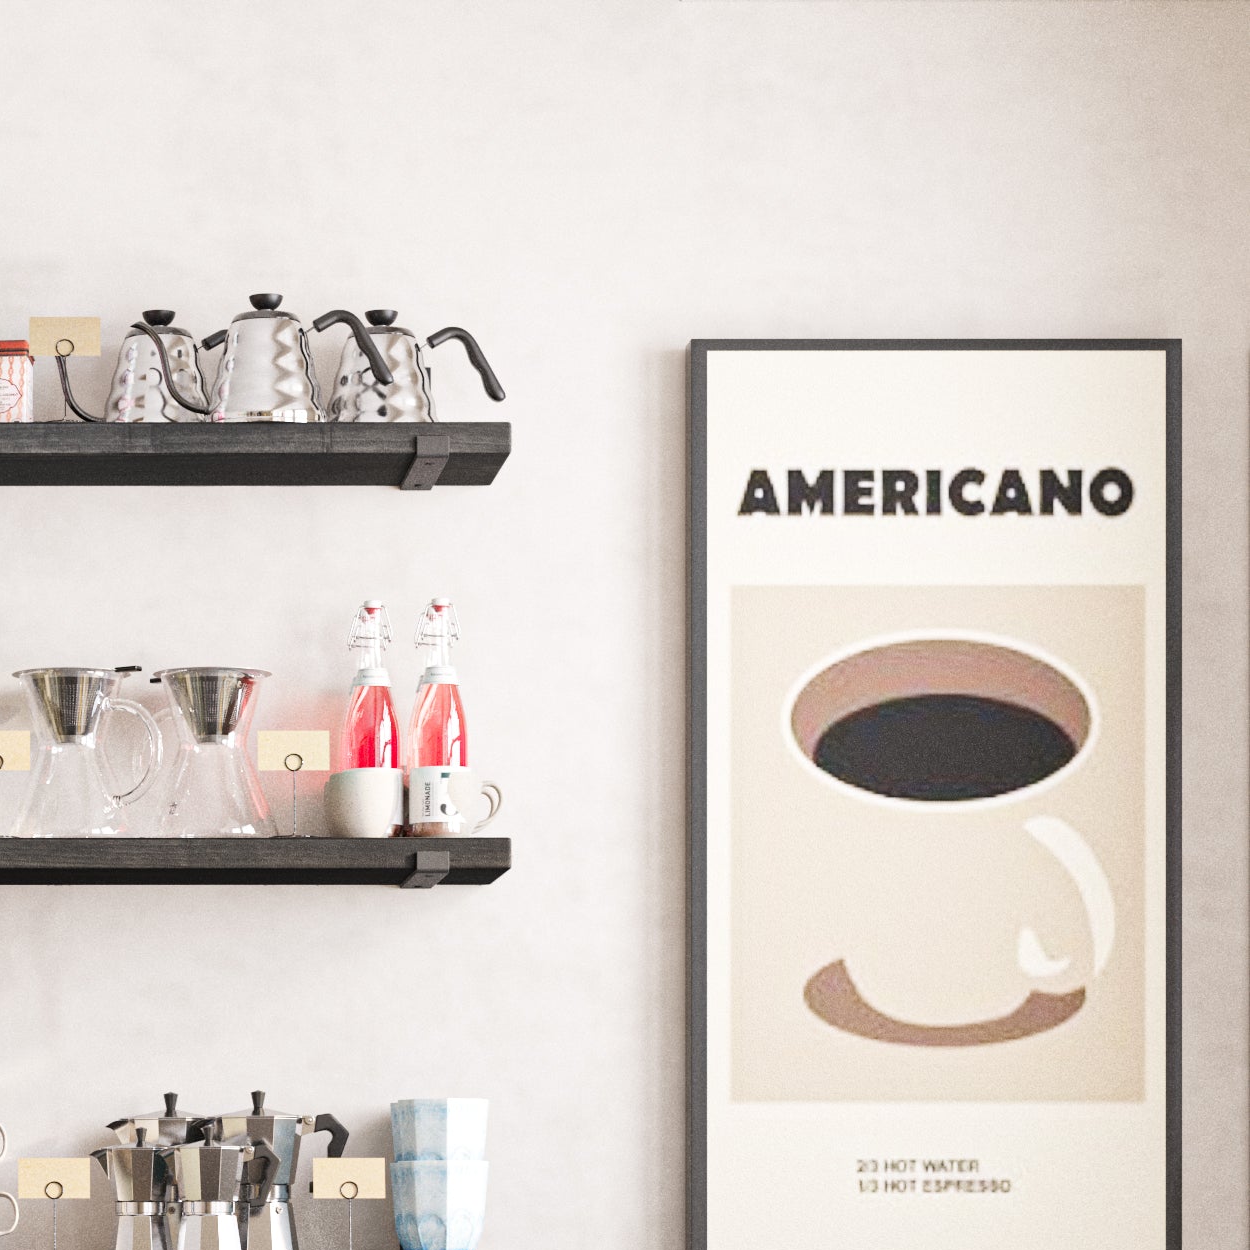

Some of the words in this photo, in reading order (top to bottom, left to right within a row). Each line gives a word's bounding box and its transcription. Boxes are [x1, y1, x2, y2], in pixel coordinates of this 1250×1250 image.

[737, 468, 1134, 517] AMERICANO
[884, 1160, 916, 1172] HOT
[922, 1160, 979, 1172] WATER
[884, 1180, 916, 1192] HOT
[922, 1180, 1011, 1192] ESPRESSO
